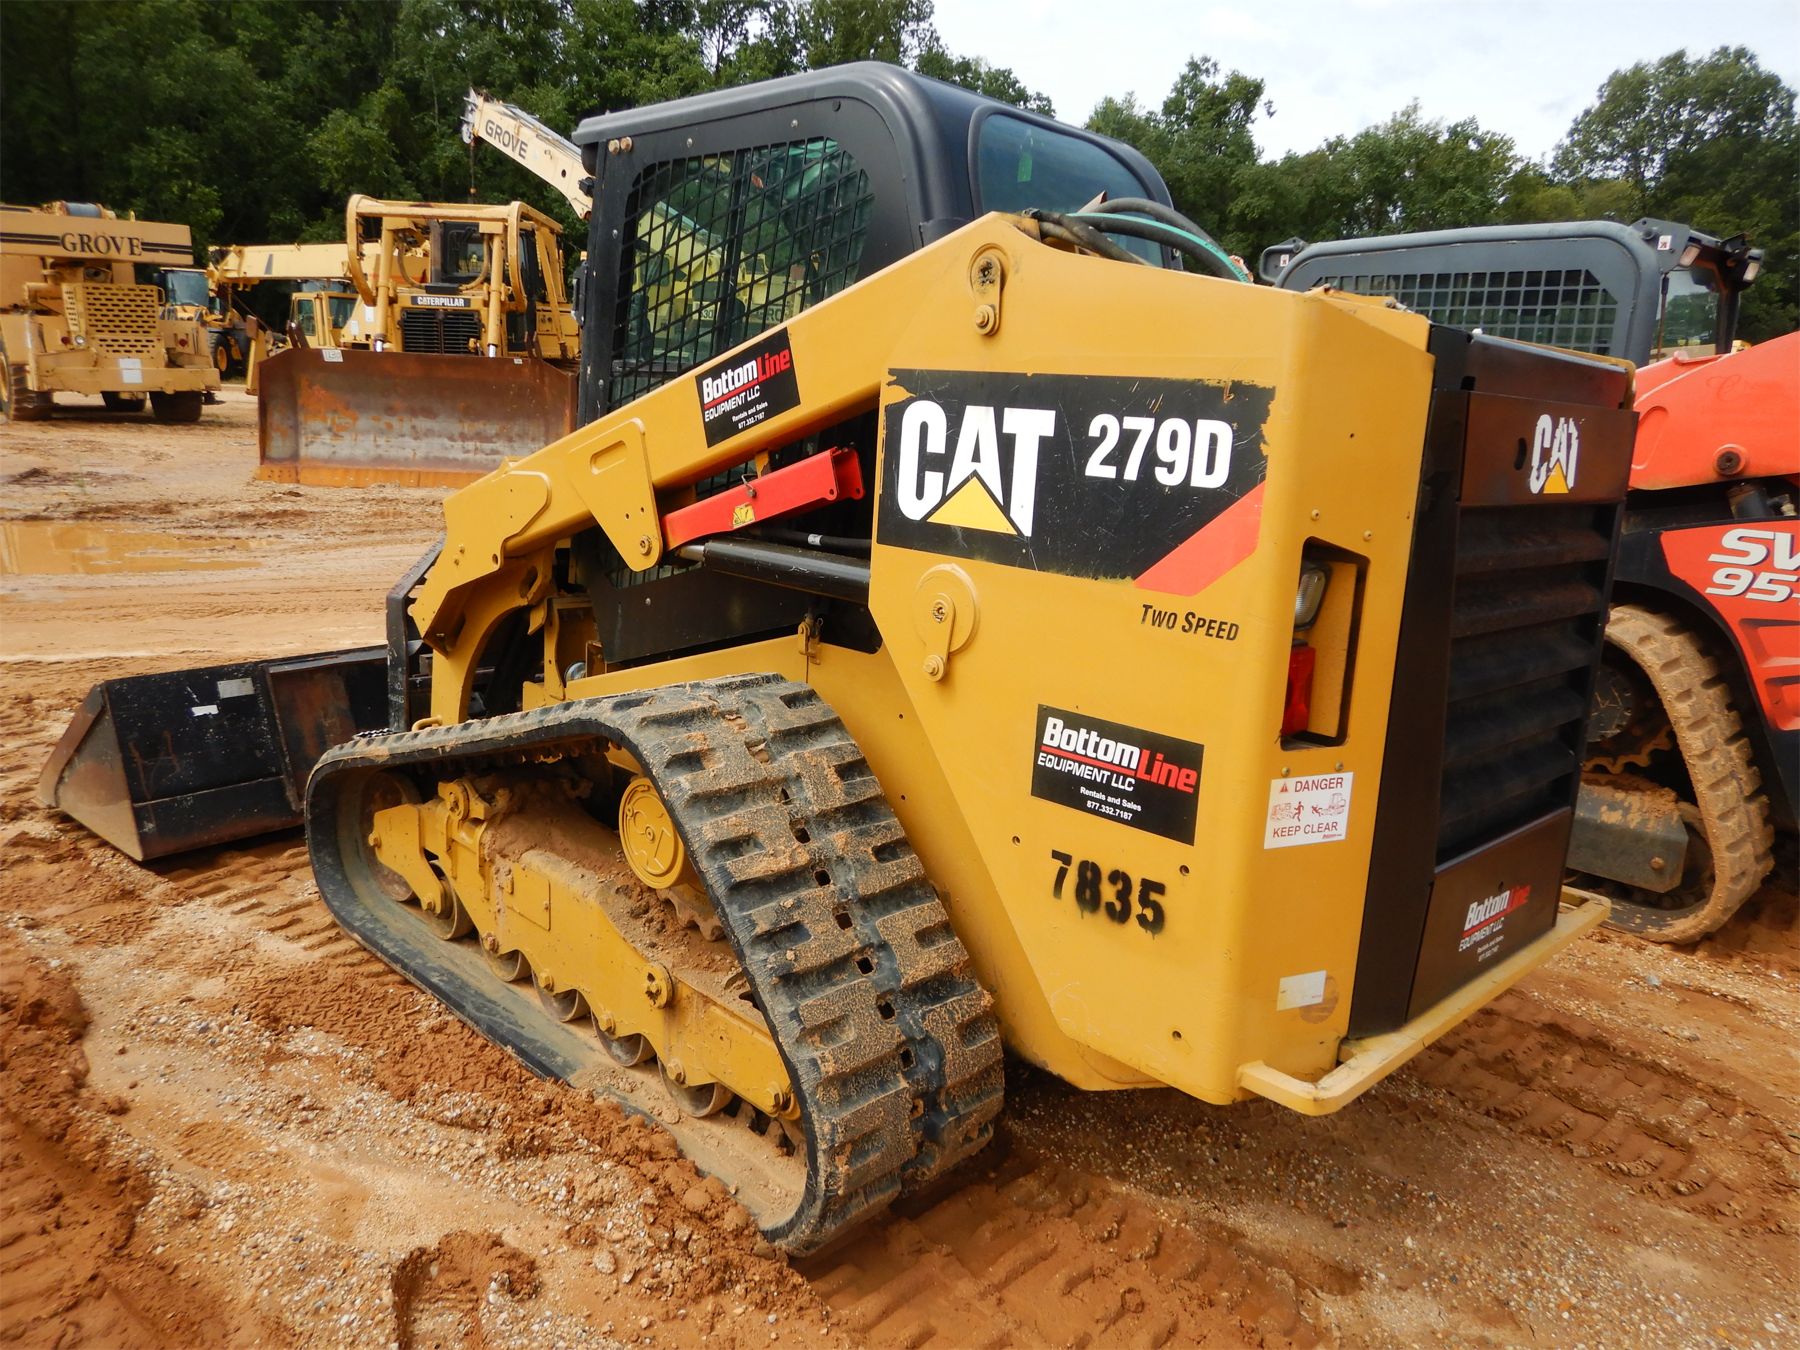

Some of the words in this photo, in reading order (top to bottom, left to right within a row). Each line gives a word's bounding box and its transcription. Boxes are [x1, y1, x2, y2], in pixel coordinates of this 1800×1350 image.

[485, 120, 528, 160] GROVE
[61, 232, 142, 256] GROVE
[417, 296, 465, 307] CATERPILLAR
[704, 393, 746, 422] EQUIPMENT
[746, 385, 761, 402] LLC
[732, 411, 748, 423] Rentals
[747, 406, 756, 416] and
[756, 401, 769, 411] Sales
[1529, 413, 1579, 494] CAT
[897, 400, 1056, 538] CAT
[1084, 413, 1234, 489] 279D
[1037, 752, 1111, 785] EQUIPMENT
[1111, 773, 1136, 792] LLC
[1294, 777, 1344, 792] DANGER
[1080, 786, 1106, 801] Rentals
[1107, 794, 1121, 806] and
[1122, 798, 1142, 812] Sales
[1086, 800, 1133, 821] 877.332.7187
[1272, 825, 1301, 838] KEEP
[1303, 821, 1338, 834] CLEAR
[1051, 849, 1166, 936] 7835
